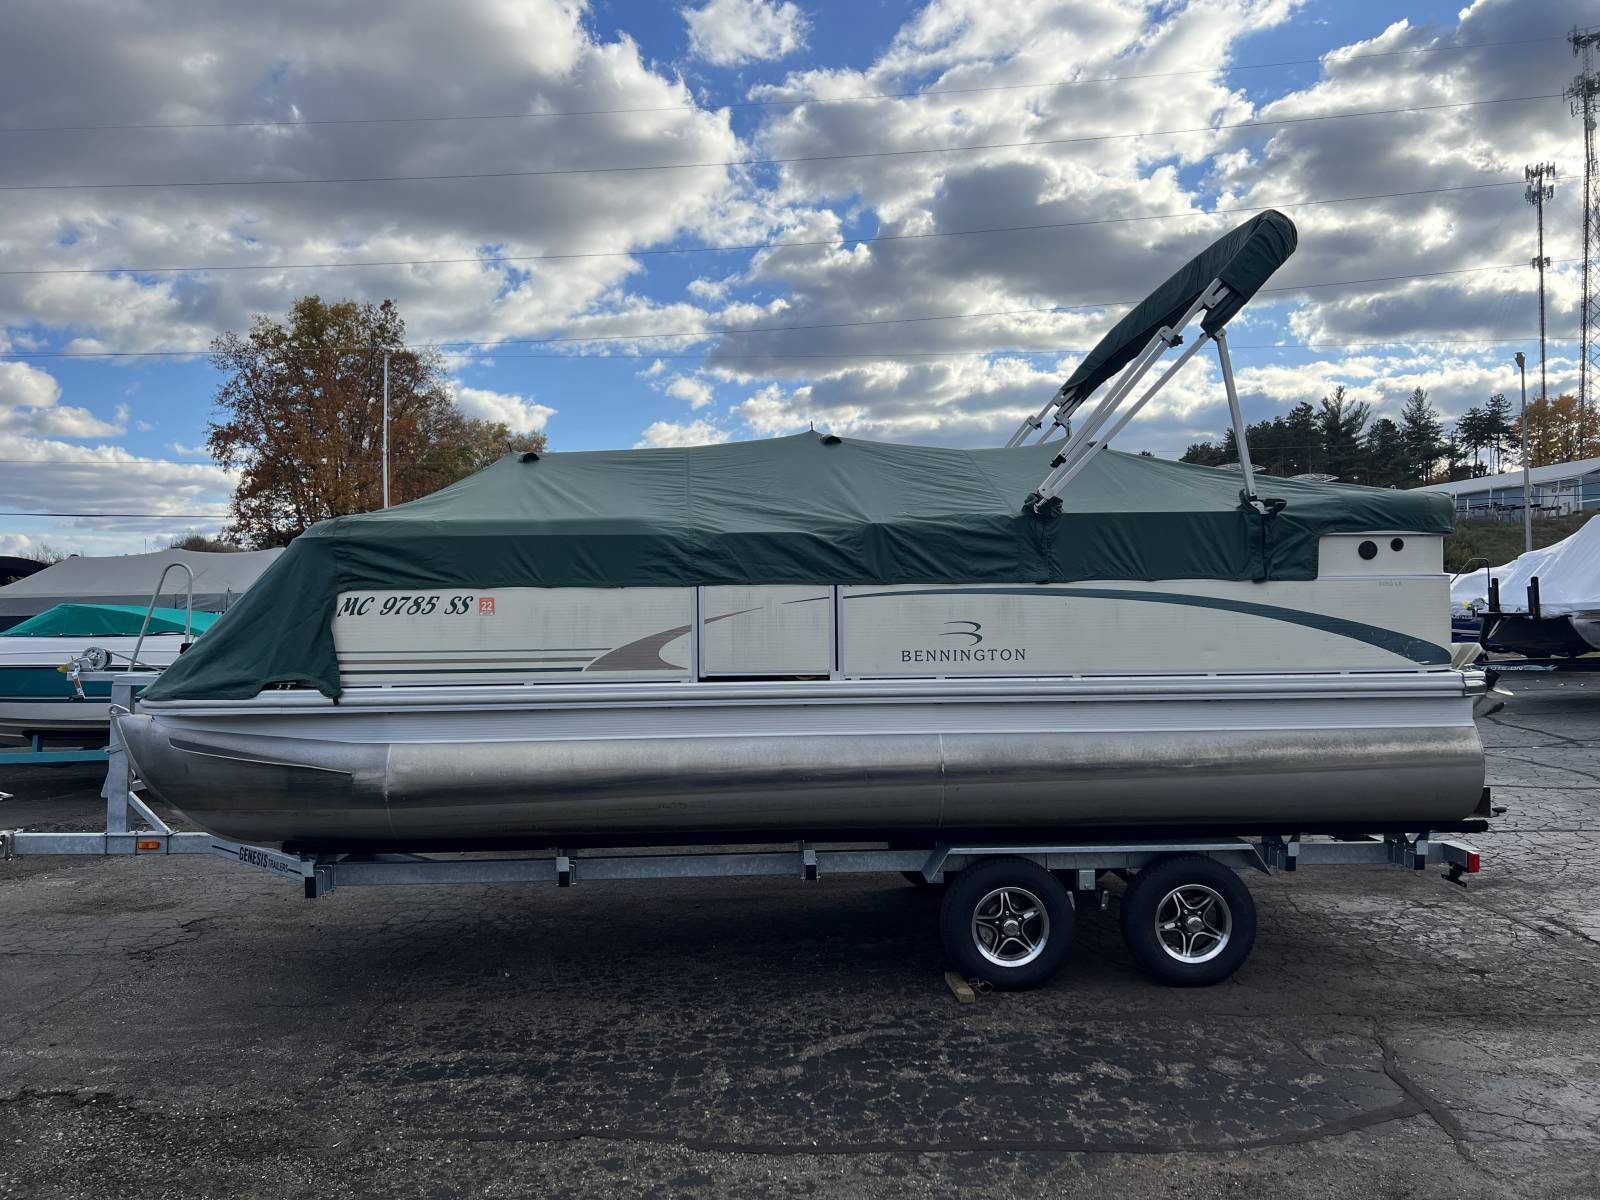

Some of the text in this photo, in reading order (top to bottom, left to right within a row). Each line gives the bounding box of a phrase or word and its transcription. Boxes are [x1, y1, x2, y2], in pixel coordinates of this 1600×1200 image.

[337, 596, 474, 617] MC 9785 SS
[481, 601, 493, 611] 22
[901, 648, 1026, 662] BENNINGTON
[239, 846, 289, 873] GENESIS TRAILERS
